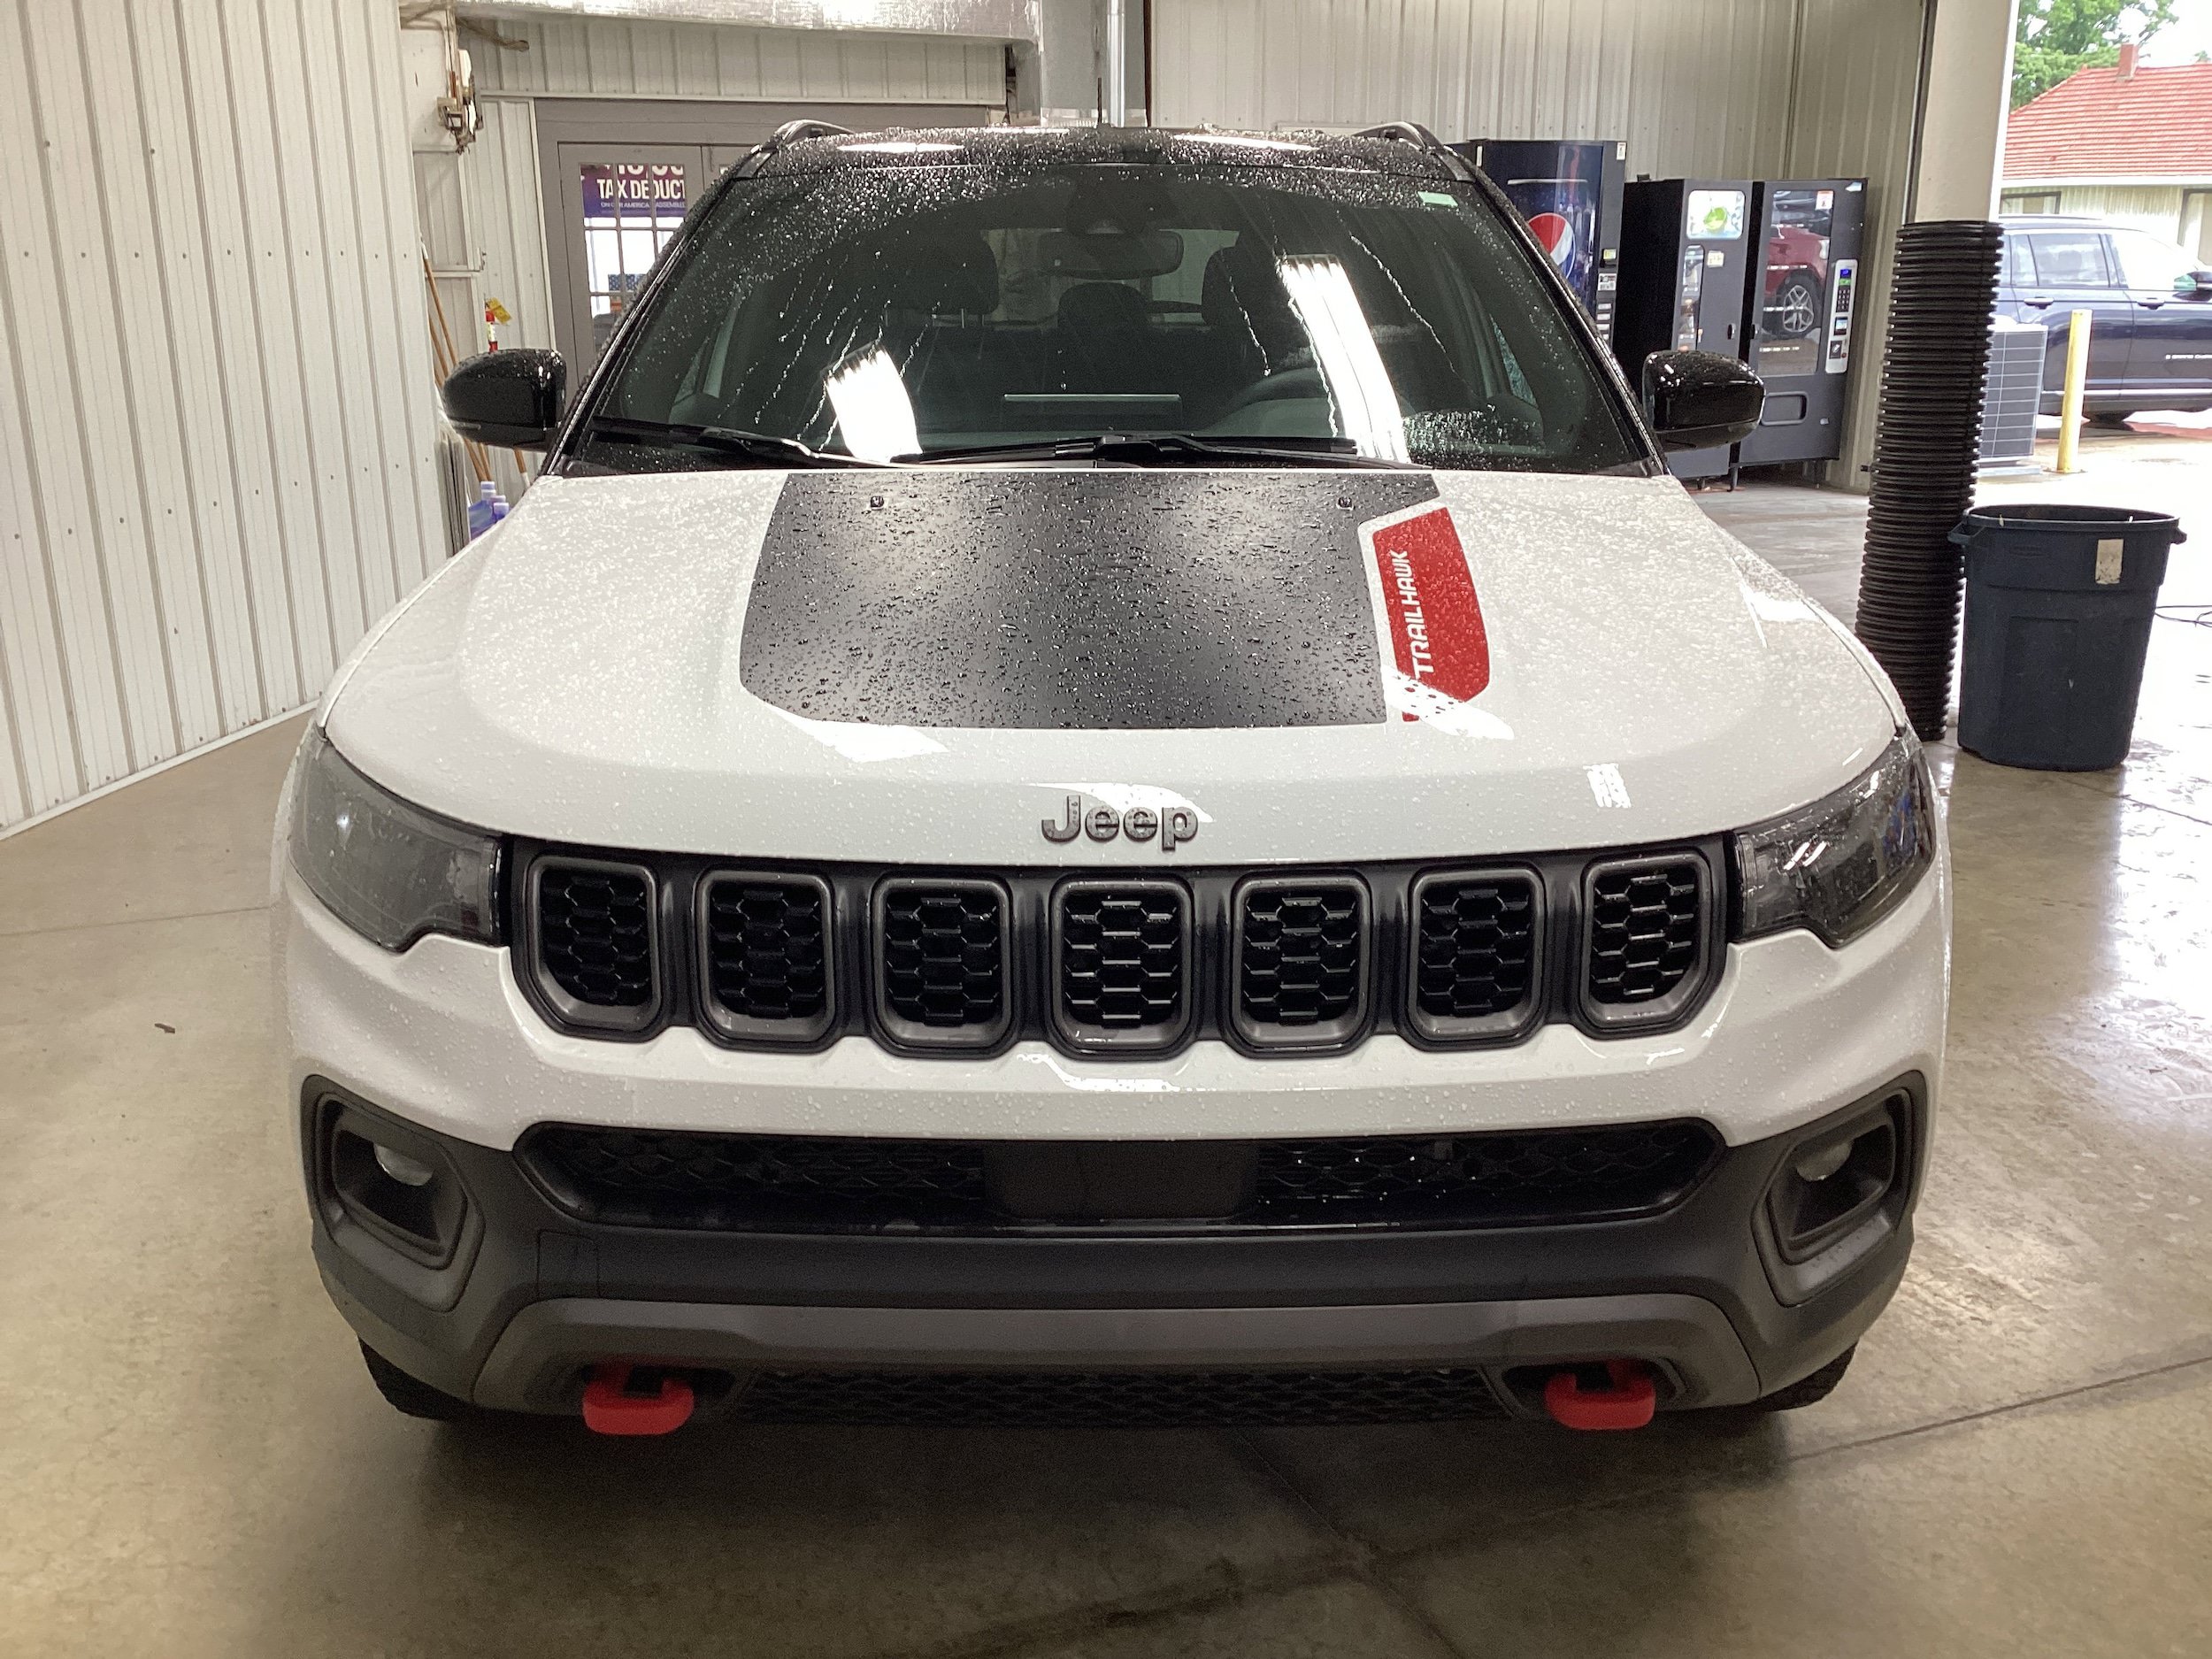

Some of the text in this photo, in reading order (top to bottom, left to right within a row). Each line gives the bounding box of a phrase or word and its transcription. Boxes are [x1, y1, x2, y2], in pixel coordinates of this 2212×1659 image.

[596, 179, 628, 199] TAX
[1390, 549, 1434, 680] TRAILHAWK
[1041, 795, 1199, 852] Jeep
